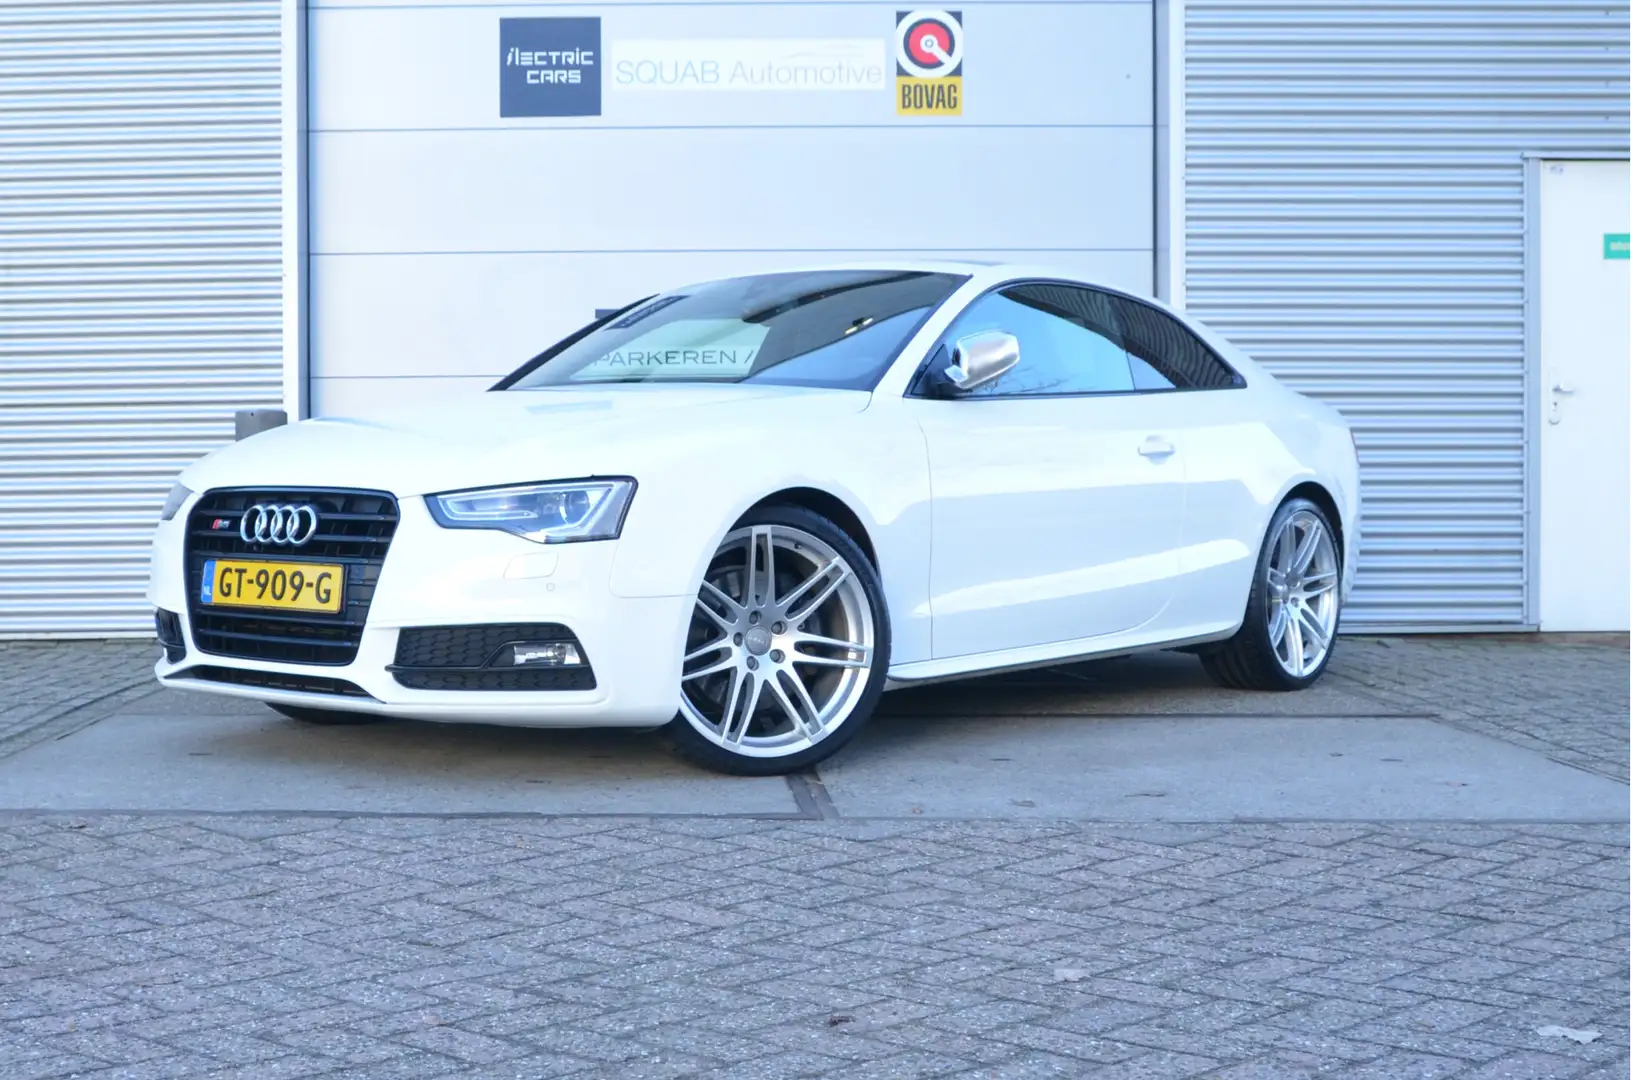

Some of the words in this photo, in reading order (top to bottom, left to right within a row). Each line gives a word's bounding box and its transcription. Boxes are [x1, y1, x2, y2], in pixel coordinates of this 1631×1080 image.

[527, 69, 581, 84] CARS
[616, 60, 720, 84] SQUAB
[729, 60, 882, 84] Automotive
[901, 84, 958, 109] BOVAG
[219, 567, 332, 604] GT-909-G
